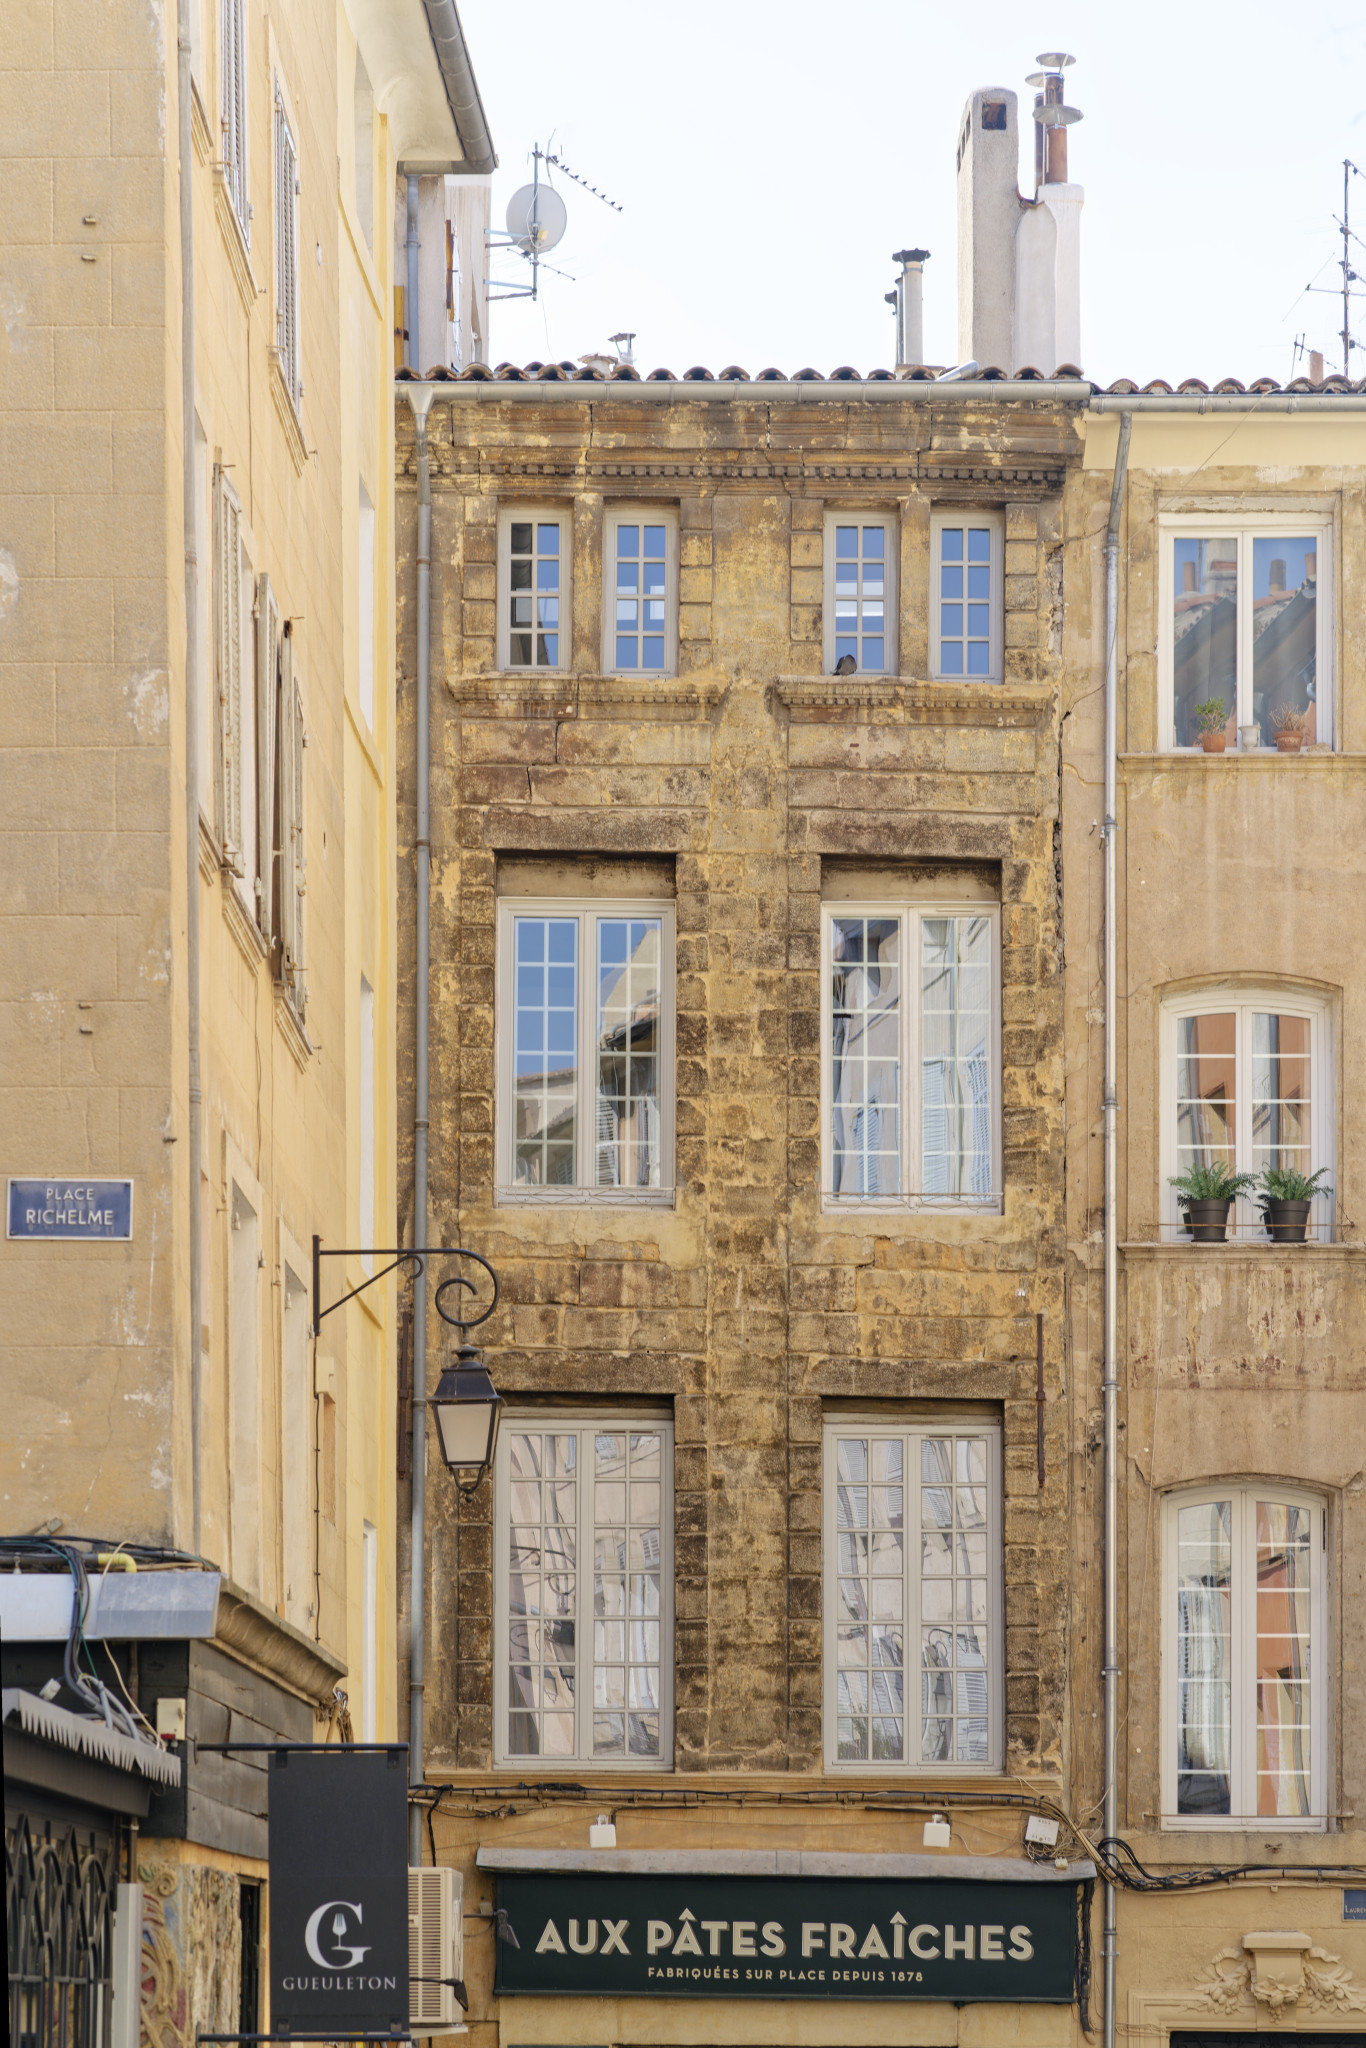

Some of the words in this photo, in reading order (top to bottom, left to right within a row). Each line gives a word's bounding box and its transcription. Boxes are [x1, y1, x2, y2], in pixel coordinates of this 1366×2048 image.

[46, 1188, 94, 1200] PLACE
[26, 1209, 113, 1225] RICHELME
[304, 1901, 372, 1970] G
[534, 1918, 632, 1955] AUX
[646, 1907, 787, 1957] PÂTES
[801, 1911, 1035, 1961] FRAÎCHES
[648, 1965, 740, 1980] FABRIQUÉES
[745, 1969, 773, 1980] SUR
[779, 1969, 826, 1981] PLACE
[832, 1970, 885, 1982] DEPUIS
[891, 1971, 924, 1982] 1878
[282, 1976, 396, 1991] GUEULETON
